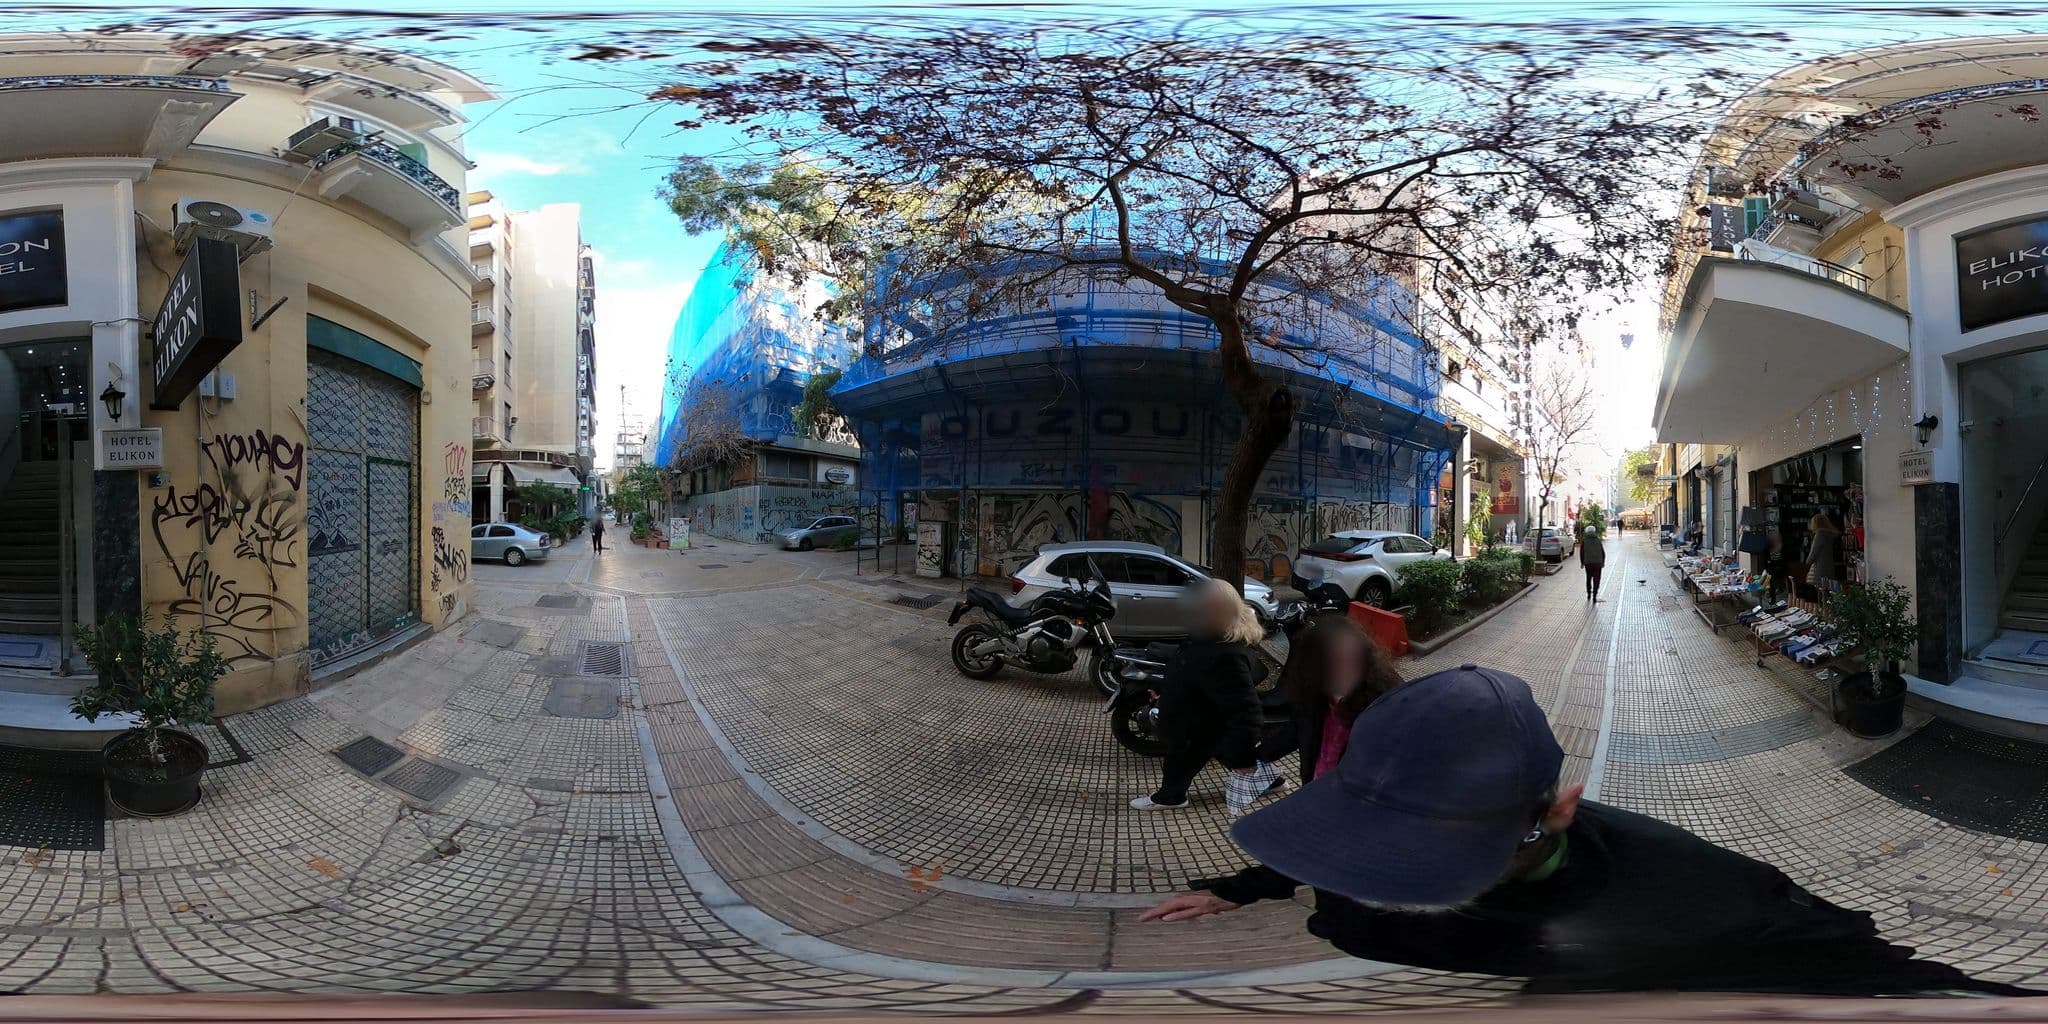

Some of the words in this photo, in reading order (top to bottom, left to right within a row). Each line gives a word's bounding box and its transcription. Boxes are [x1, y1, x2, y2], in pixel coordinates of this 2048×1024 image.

[1969, 246, 2048, 275] ELIK
[1982, 265, 2044, 290] HOT
[155, 271, 191, 345] HOTEL
[155, 296, 198, 386] ELIKON
[111, 436, 152, 446] HOTEL
[109, 451, 155, 461] ELIKON
[1903, 457, 1927, 467] HOTEL
[1902, 469, 1929, 479] ELIKON
